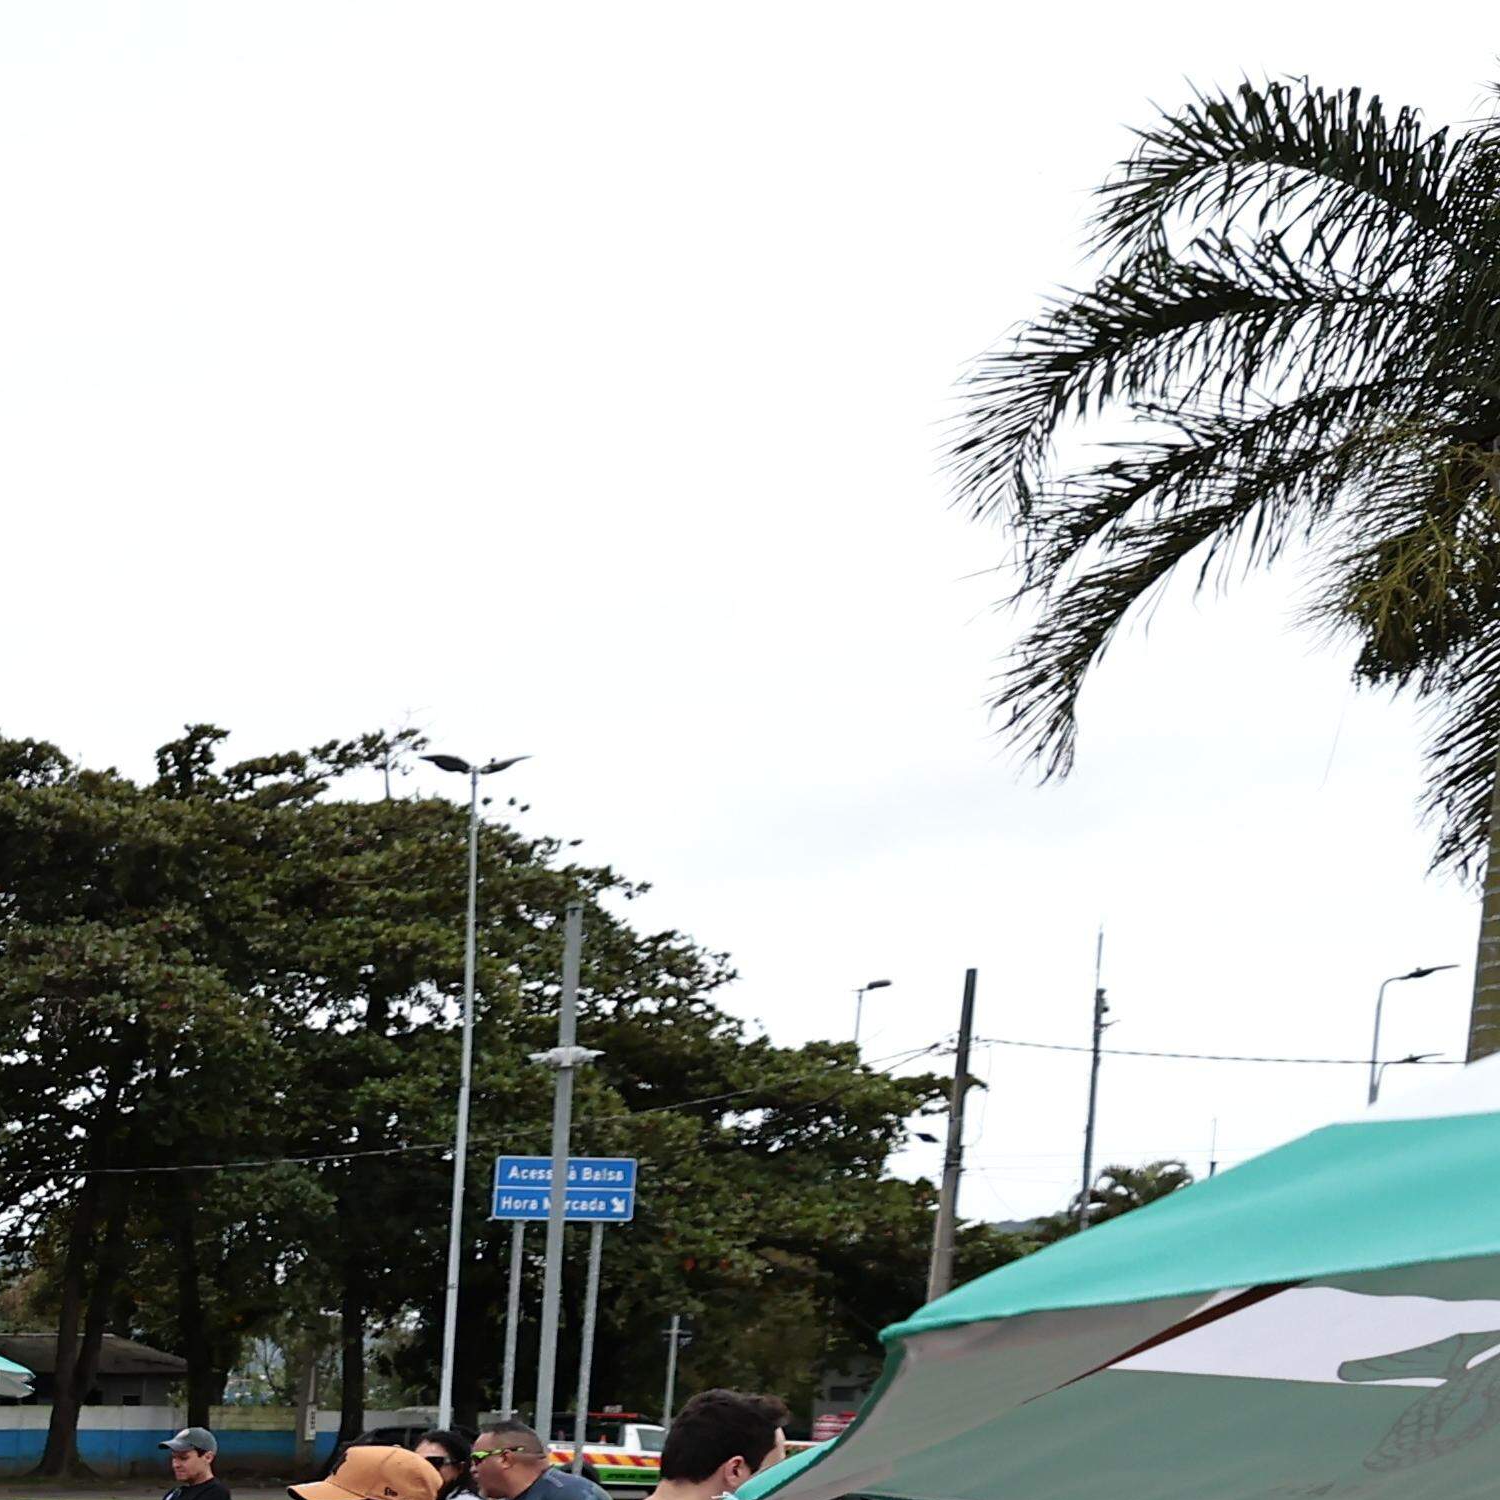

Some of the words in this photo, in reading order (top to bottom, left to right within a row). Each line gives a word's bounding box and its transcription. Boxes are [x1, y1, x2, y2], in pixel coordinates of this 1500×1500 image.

[508, 1165, 553, 1180] Acess
[582, 1167, 624, 1181] Balsa
[501, 1196, 538, 1210] Hora
[542, 1197, 606, 1211] Mrcada
